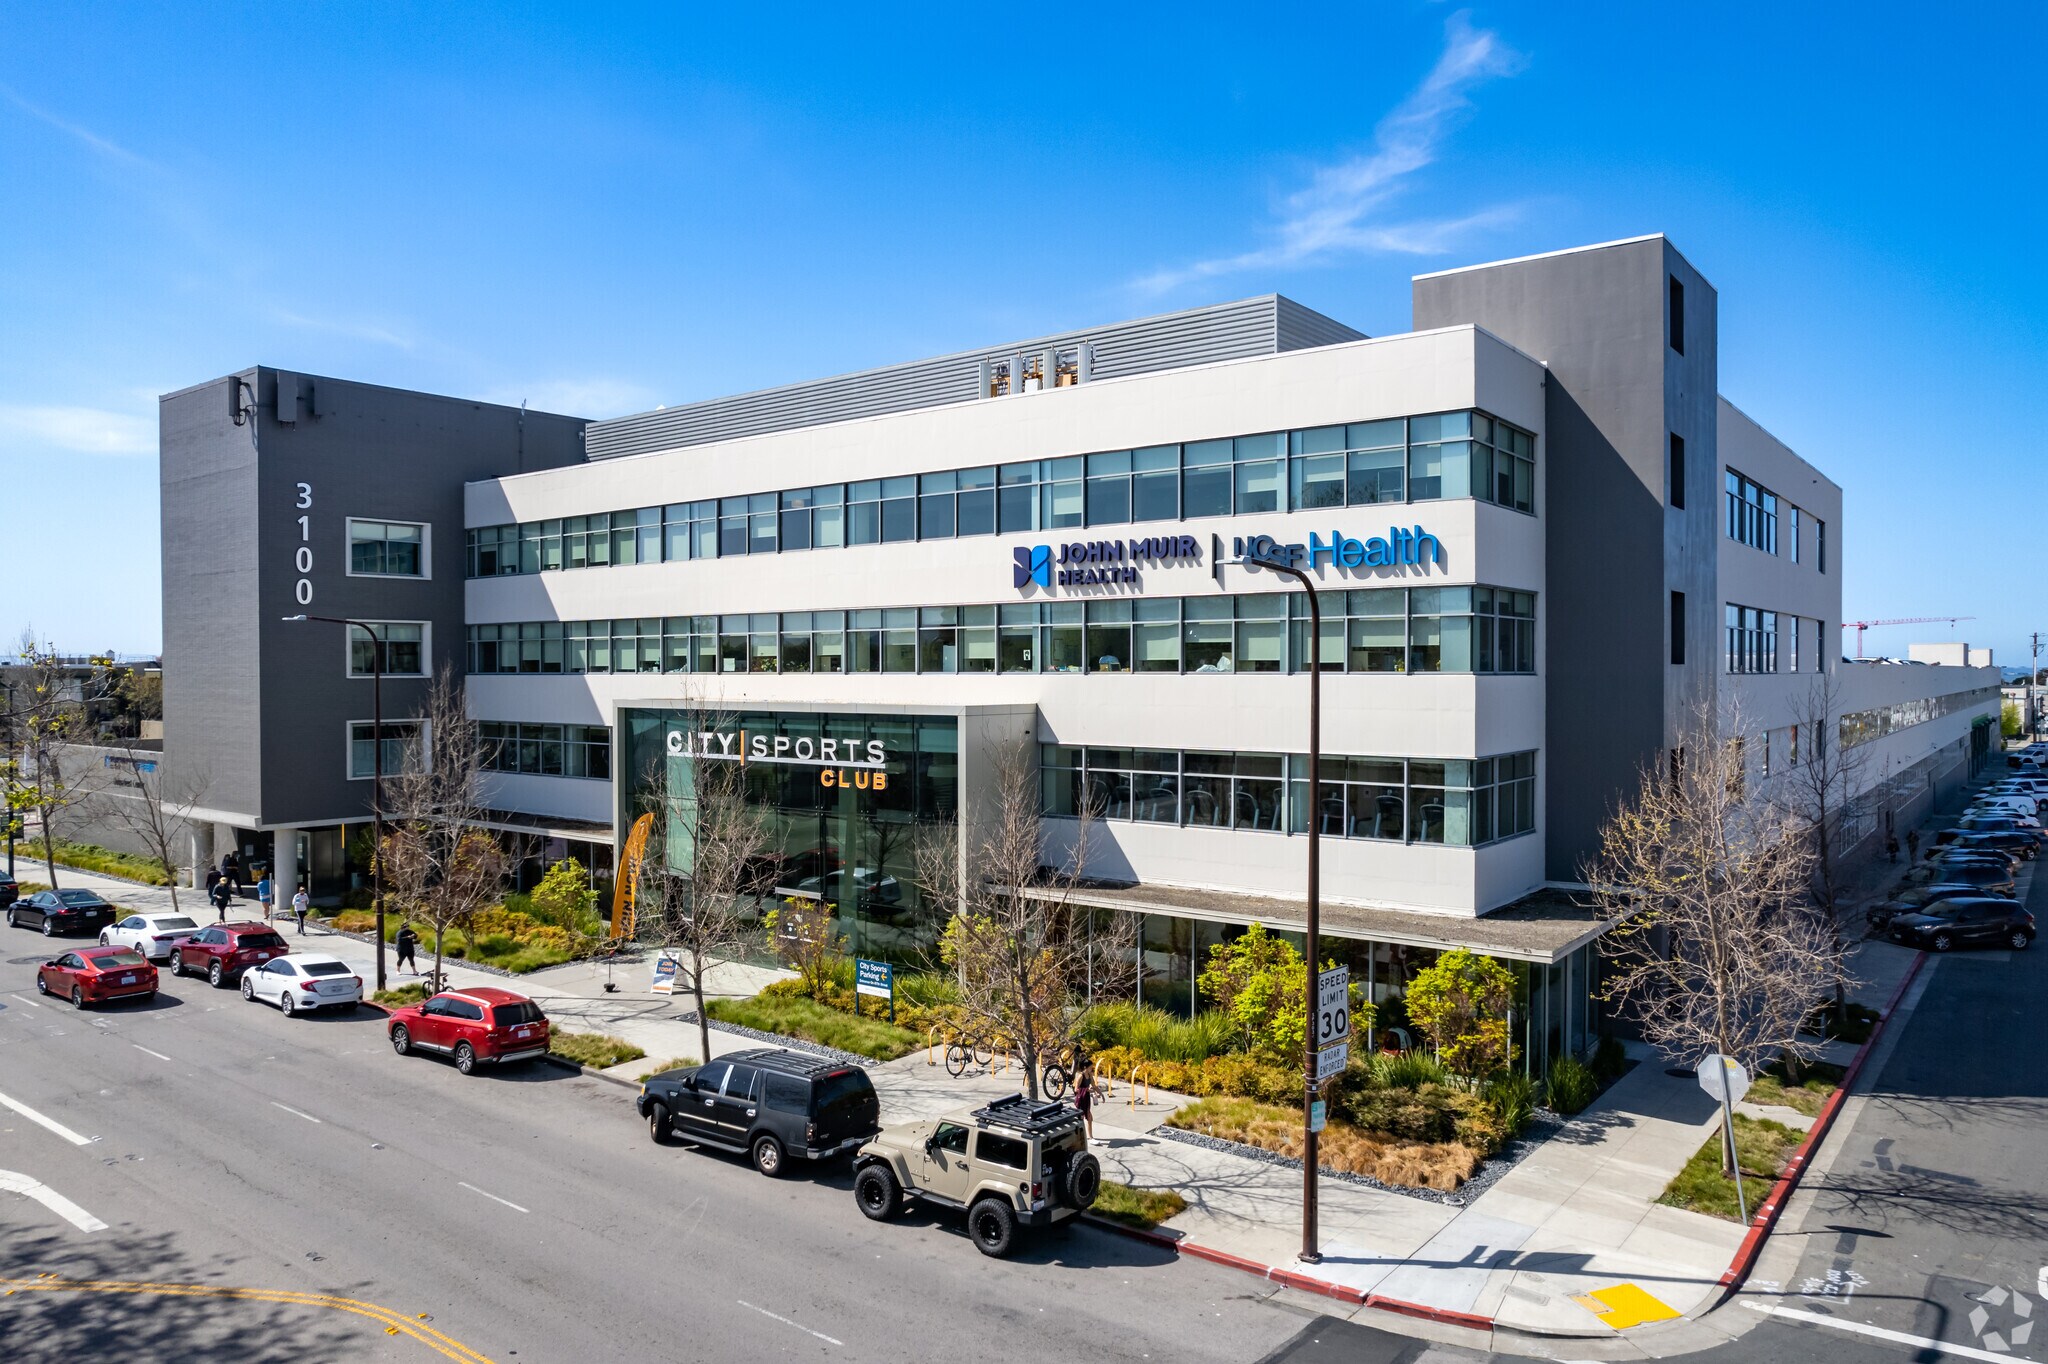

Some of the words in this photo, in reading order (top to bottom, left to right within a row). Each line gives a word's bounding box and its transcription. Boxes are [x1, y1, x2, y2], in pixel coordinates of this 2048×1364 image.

[296, 482, 313, 605] 3100
[1056, 539, 1122, 564] JOHN
[1129, 535, 1196, 560] MUIR
[1233, 535, 1305, 568] UCSF
[1309, 524, 1439, 568] Health
[1058, 567, 1137, 585] HEALTH
[667, 730, 735, 755] CITY
[752, 735, 885, 763] SPORTS
[821, 769, 888, 790] CLUB
[860, 962, 869, 970] City
[870, 964, 887, 973] Sports
[860, 970, 880, 981] Parking
[1320, 973, 1346, 990] SPEED
[1322, 990, 1344, 1006] LIMIT
[1321, 1008, 1346, 1039] 30
[1324, 1048, 1340, 1060] RADAR
[1320, 1059, 1344, 1076] ENFORCED
